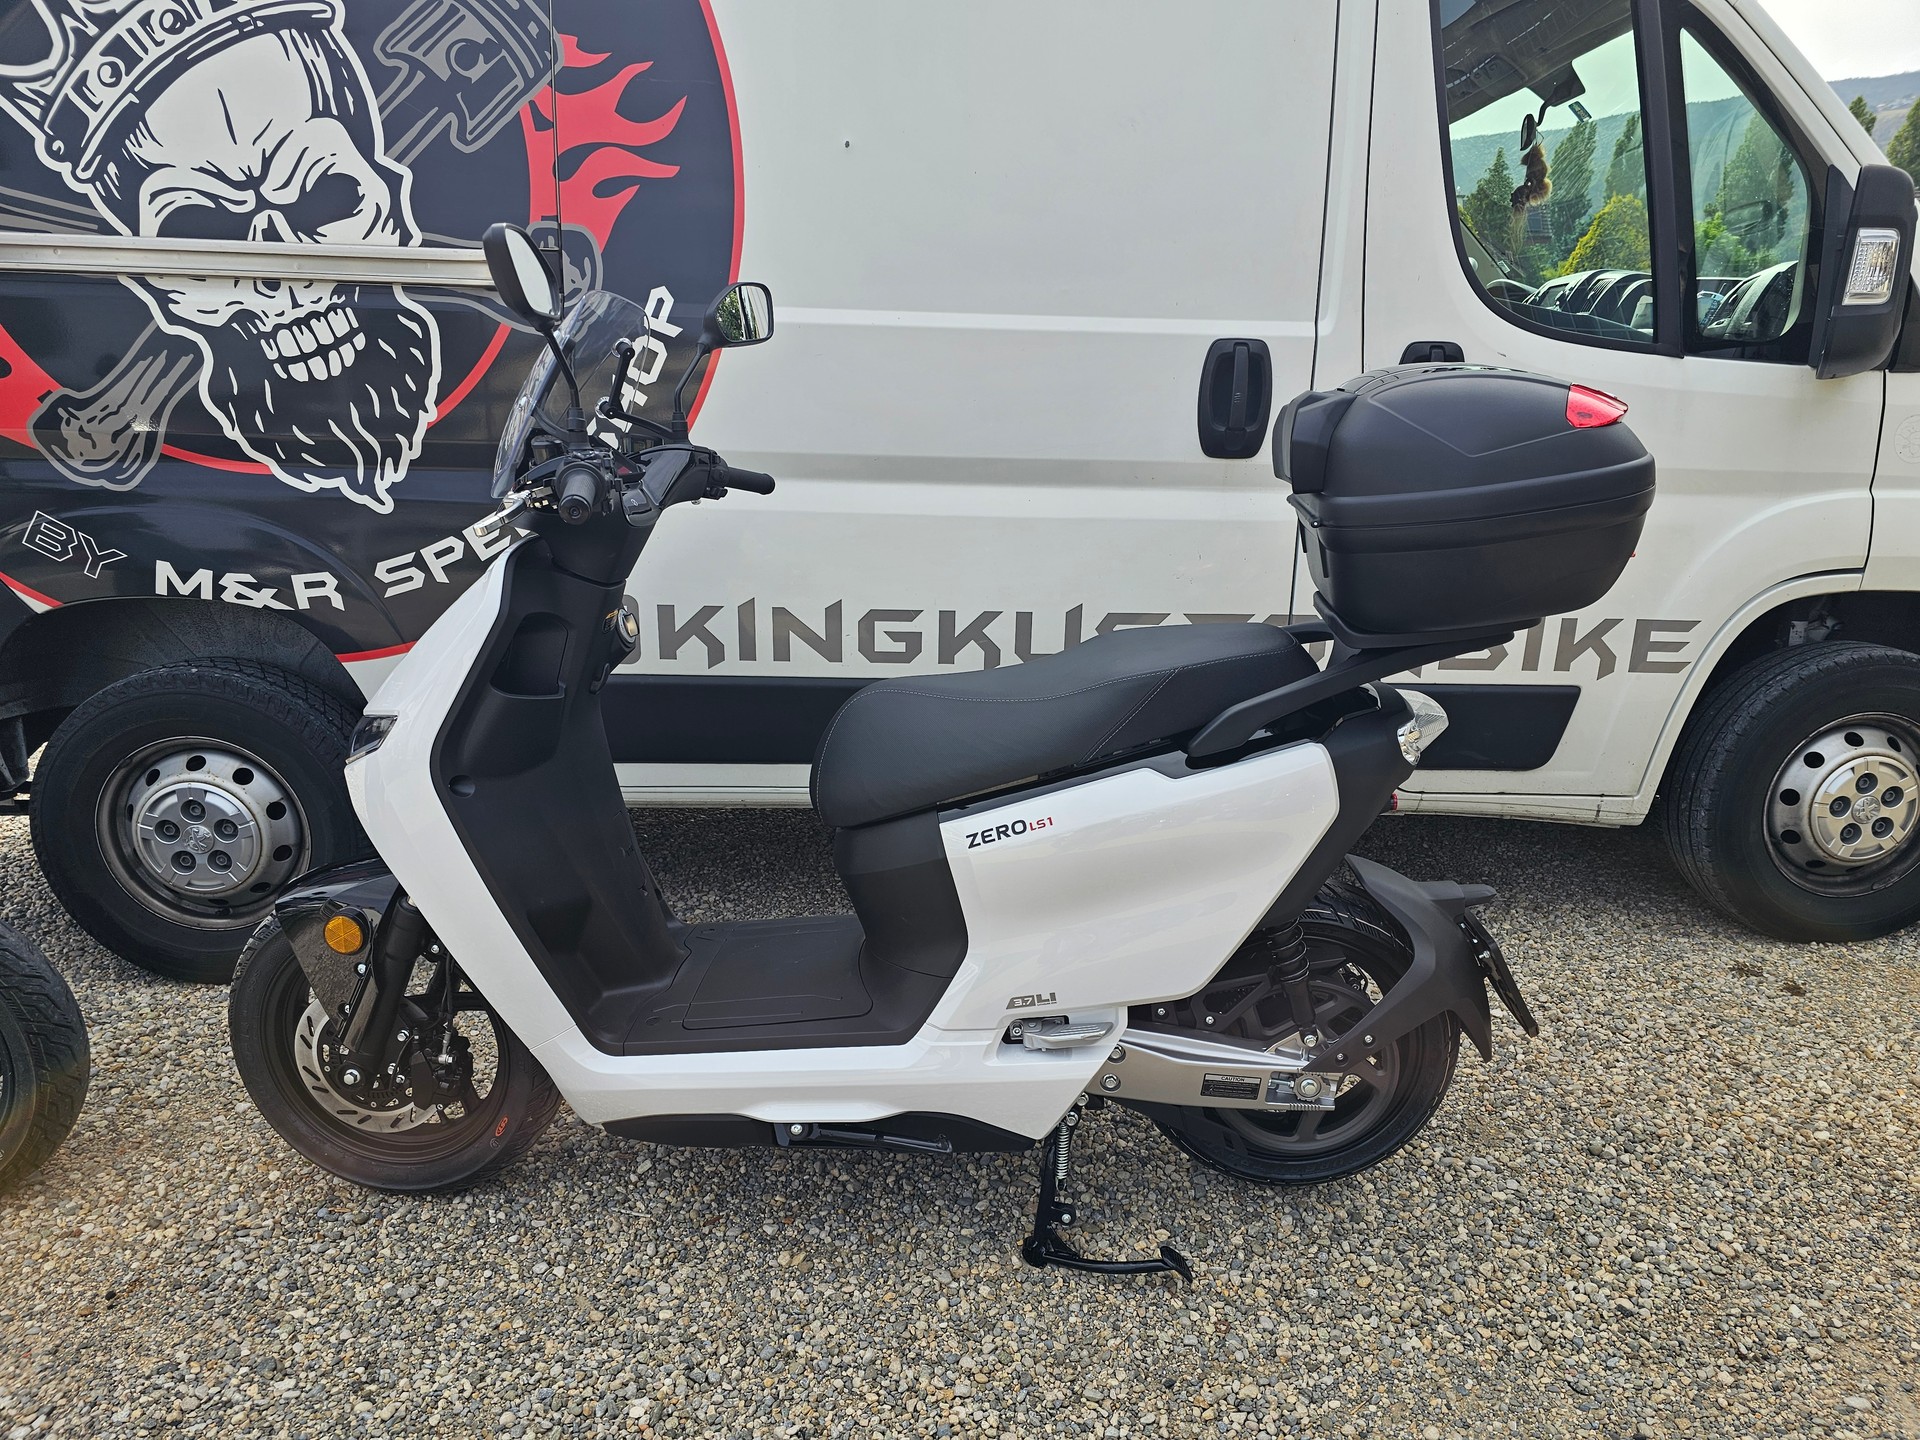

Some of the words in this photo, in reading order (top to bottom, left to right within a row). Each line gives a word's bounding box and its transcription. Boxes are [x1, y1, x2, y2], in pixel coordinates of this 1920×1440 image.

[21, 510, 127, 579] BY
[155, 559, 346, 611] M&R
[586, 285, 684, 450] HOP
[965, 819, 1028, 849] ZERO
[1029, 816, 1054, 831] LS1
